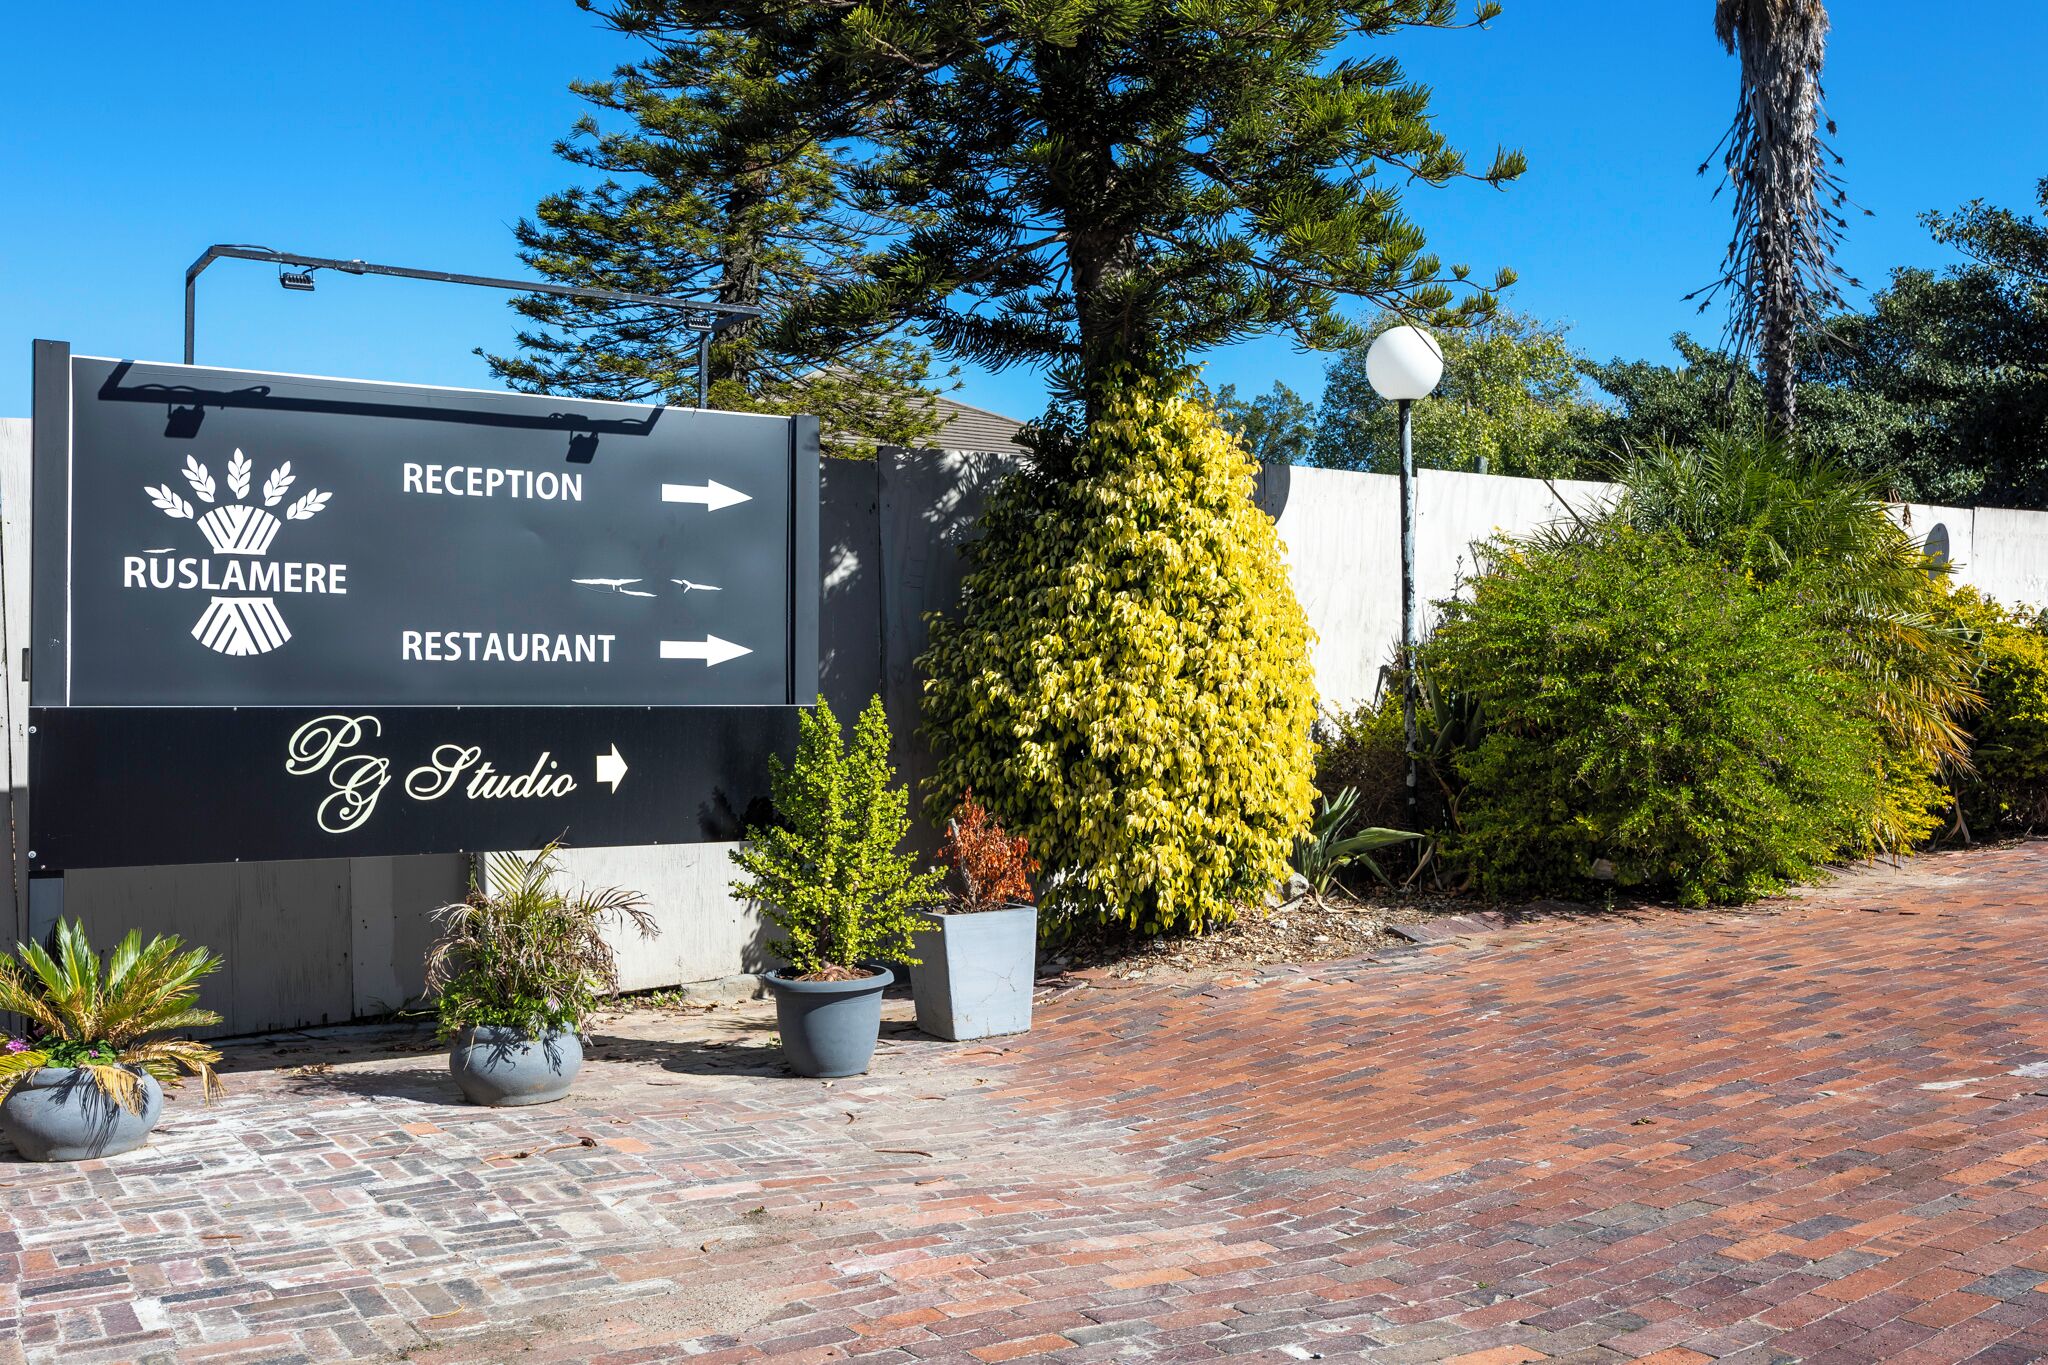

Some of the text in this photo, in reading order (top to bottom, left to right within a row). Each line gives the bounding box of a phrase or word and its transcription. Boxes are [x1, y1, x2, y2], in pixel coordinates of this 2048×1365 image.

[403, 462, 583, 502] RECEPTION
[123, 556, 347, 595] RUSLAMERE
[402, 630, 616, 663] RESTAURANT
[404, 744, 578, 801] Studio
